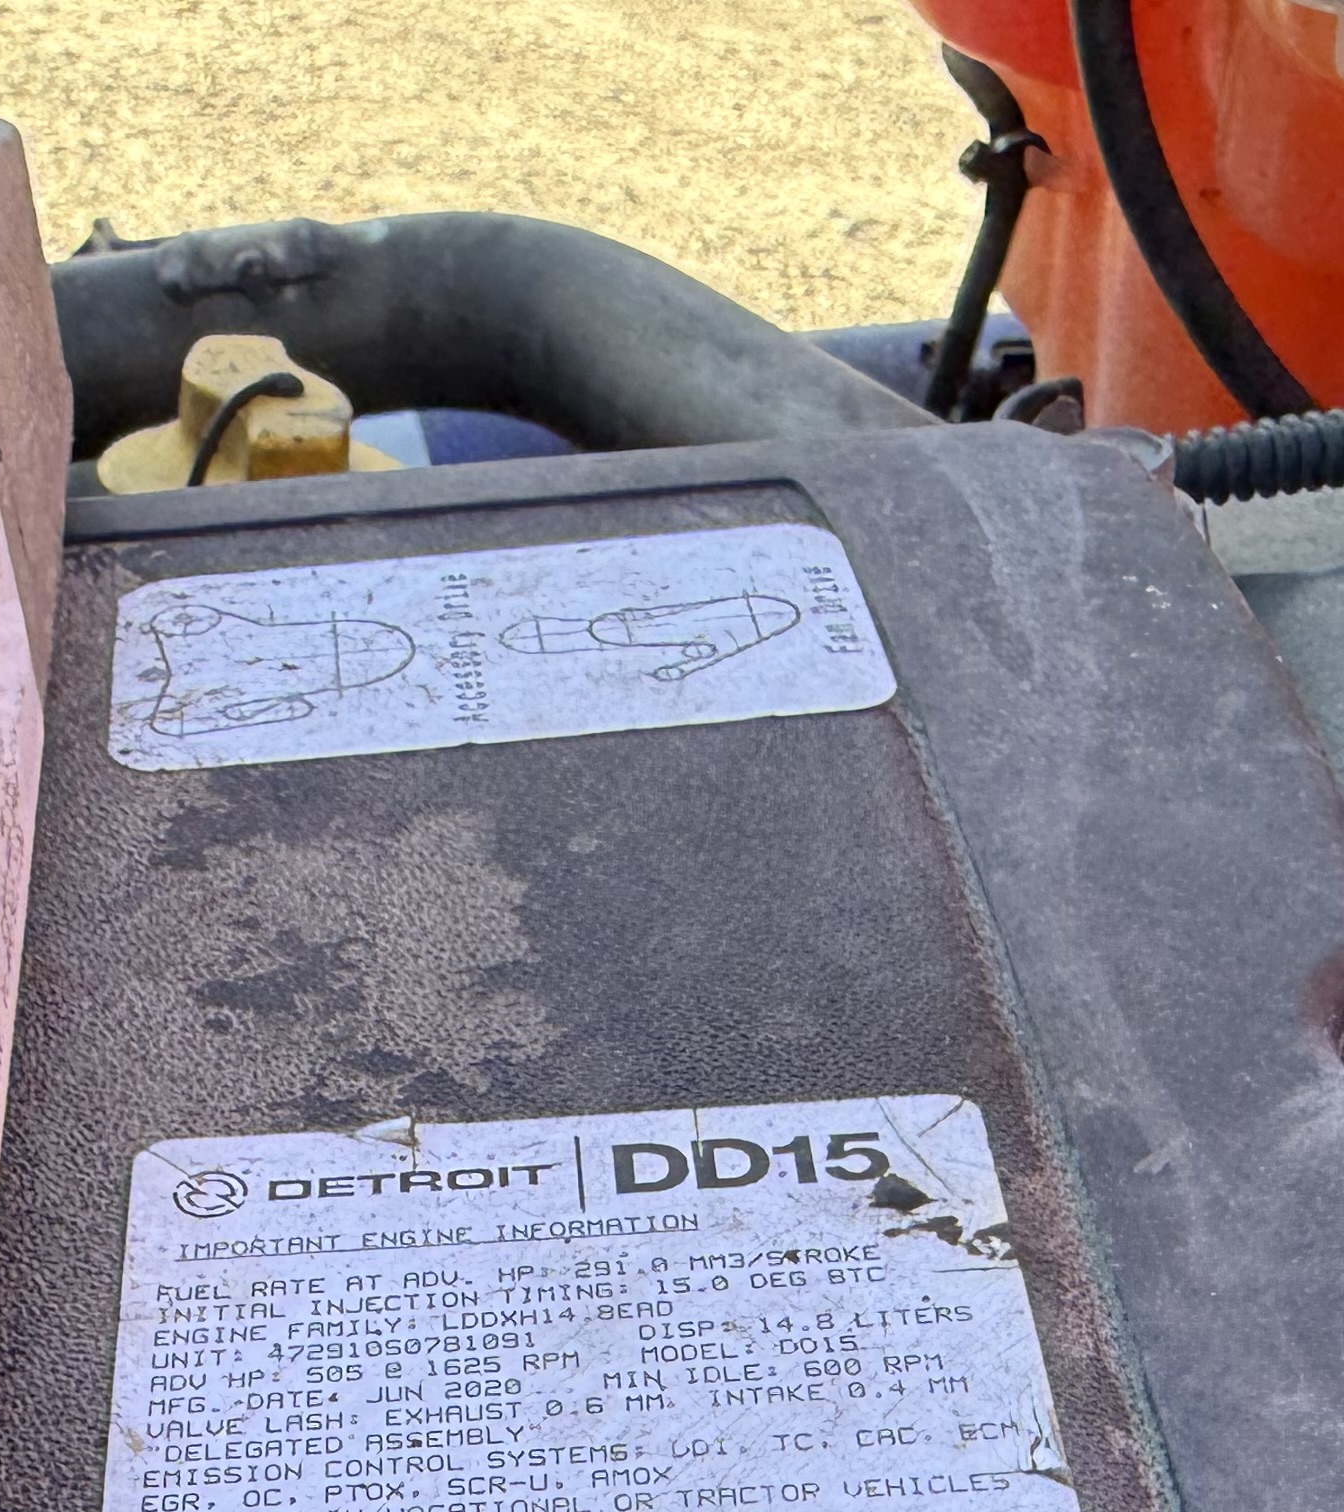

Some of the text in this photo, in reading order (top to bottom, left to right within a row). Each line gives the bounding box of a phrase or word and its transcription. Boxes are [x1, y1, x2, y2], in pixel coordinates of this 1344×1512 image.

[267, 1131, 891, 1200] DETROIT DD15
[178, 1213, 699, 1260] IMPORTANT ENGINE INFORMATION
[156, 1280, 232, 1303] FUEL
[250, 1275, 326, 1298] RATE
[345, 1272, 383, 1292] AT
[403, 1267, 474, 1289] ADV.
[158, 1300, 286, 1324] INITIAL
[310, 1289, 479, 1316] INJECTION
[493, 1281, 628, 1306] TIMING:
[656, 1276, 729, 1297] 15.0
[749, 1271, 807, 1291] DEG
[153, 1323, 268, 1347] ENGINE
[759, 1313, 835, 1335] 14.8
[853, 1305, 974, 1329] LITERS
[149, 1372, 208, 1393] ADV
[305, 1363, 364, 1384] 505
[427, 1355, 502, 1377] 1625
[522, 1350, 581, 1371] RPM
[151, 1347, 244, 1370] UNIT:
[640, 1340, 755, 1365] MODEL:
[603, 1354, 945, 1391] MIN IDLE: 600 RPM
[146, 1417, 244, 1440] VALVE
[264, 1410, 359, 1433] LASH:
[385, 1401, 523, 1427] EXHAUST
[710, 1384, 827, 1408] INTAKE
[848, 1380, 906, 1401] 0.4
[928, 1376, 971, 1396] MM
[147, 1395, 221, 1416] MFG.
[365, 1383, 424, 1404] JUN
[444, 1378, 522, 1400] 2020
[142, 1461, 304, 1488] EMISSION
[324, 1452, 465, 1478] CONTROL
[140, 1492, 217, 1512] EGR,
[241, 1488, 298, 1507] OC,
[591, 1467, 673, 1488] AMOX
[613, 1493, 654, 1512] OR
[675, 1483, 821, 1509] TRACTOR
[843, 1473, 1011, 1500] VEHICLES
